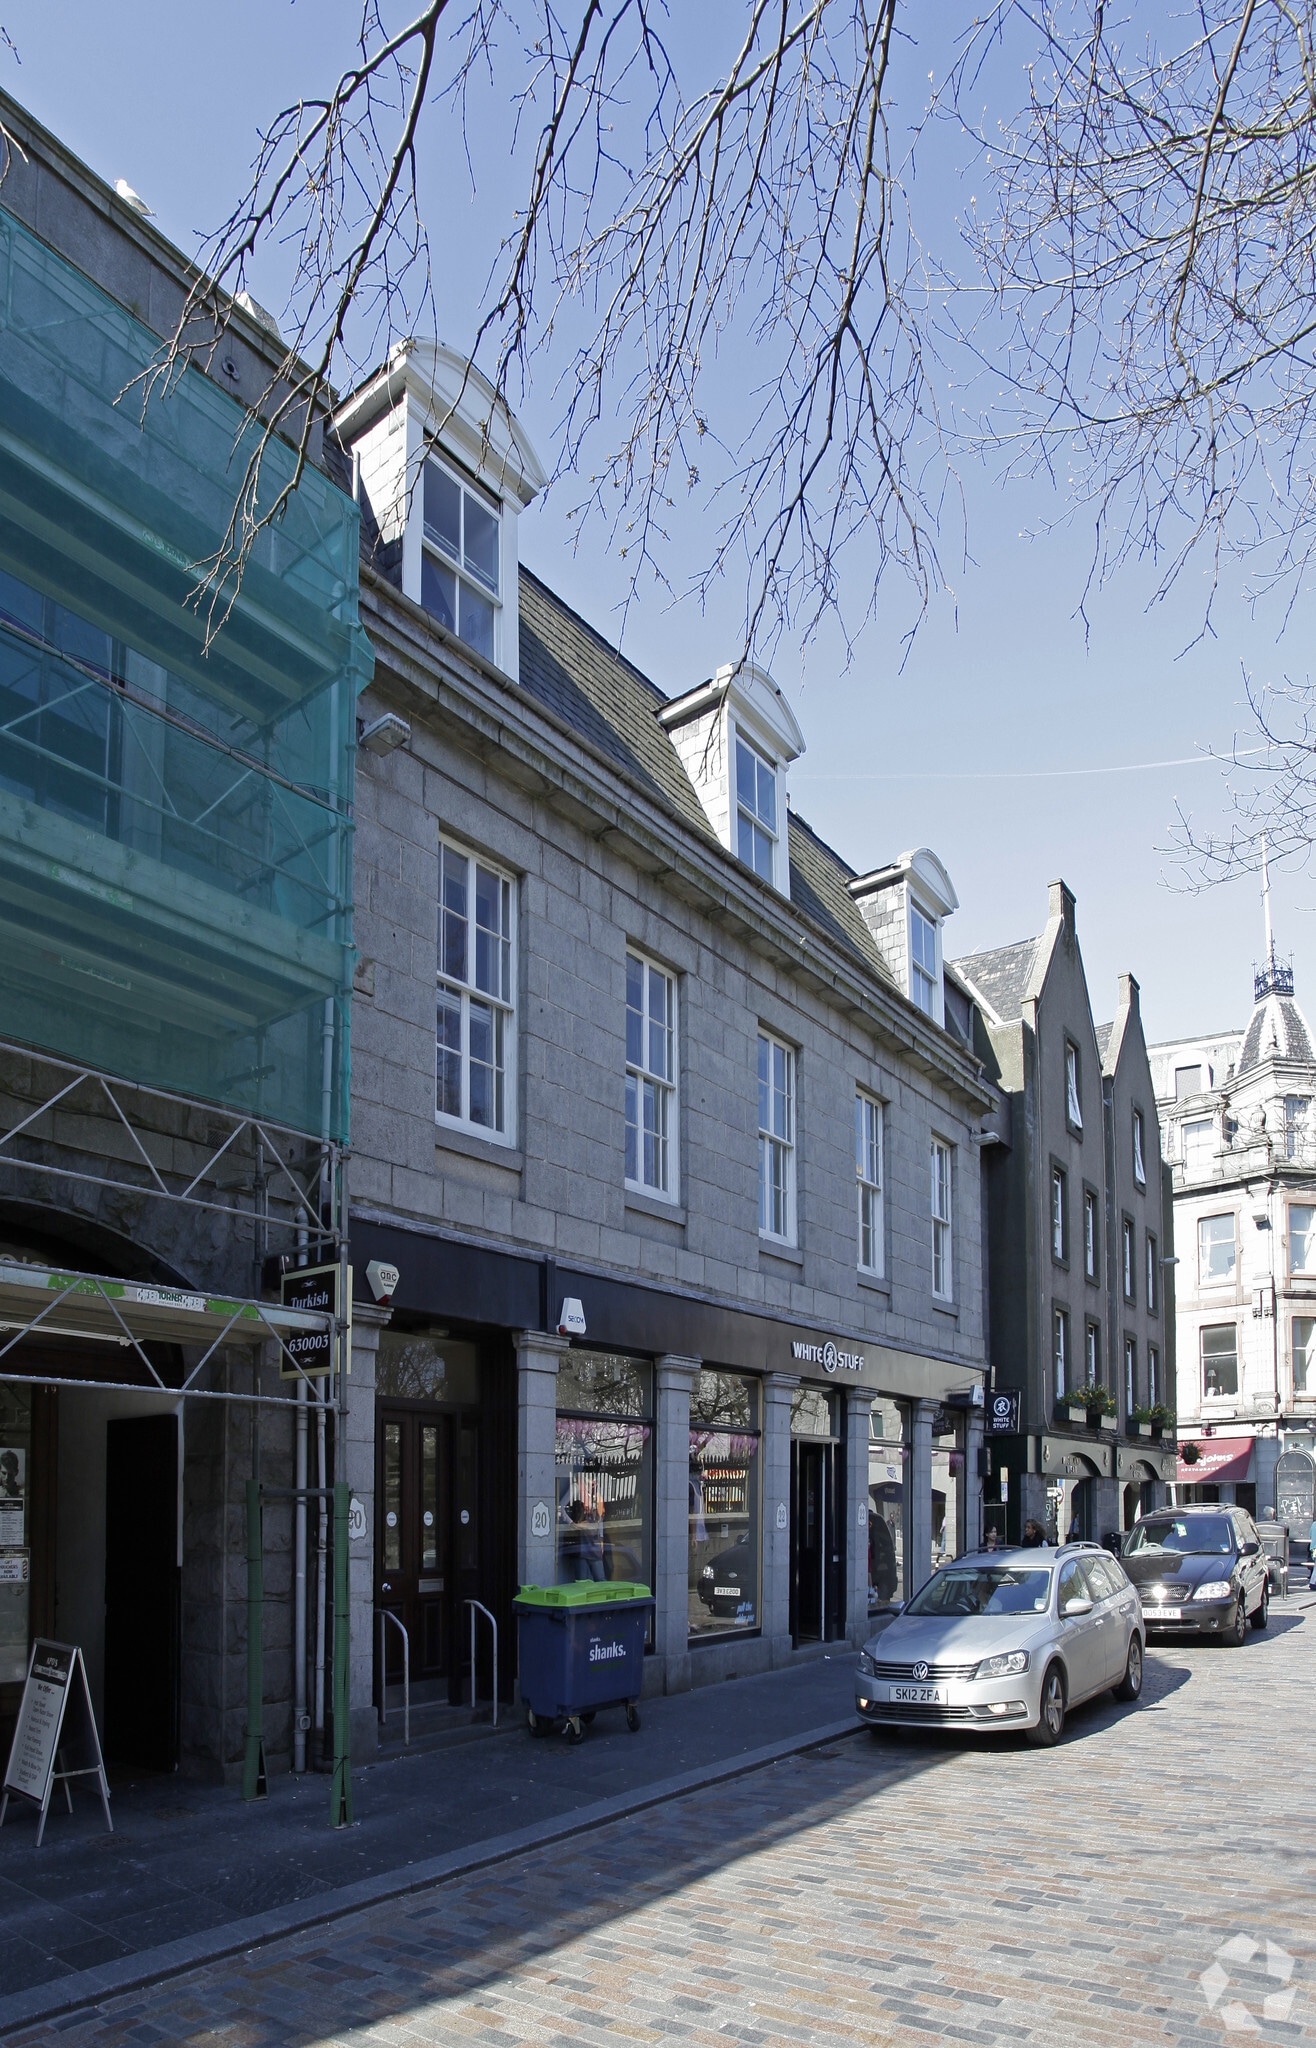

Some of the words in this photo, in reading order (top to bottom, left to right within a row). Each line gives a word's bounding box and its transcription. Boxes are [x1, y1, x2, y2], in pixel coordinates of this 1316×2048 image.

[291, 1291, 329, 1309] Turkish
[289, 1335, 329, 1352] 630003
[793, 1341, 823, 1363] WHITE
[838, 1352, 865, 1371] STUFF
[535, 1512, 547, 1528] 20
[778, 1509, 786, 1522] 22
[589, 1641, 626, 1661] shanks.
[896, 1688, 917, 1700] SK12
[920, 1689, 940, 1701] ZFA
